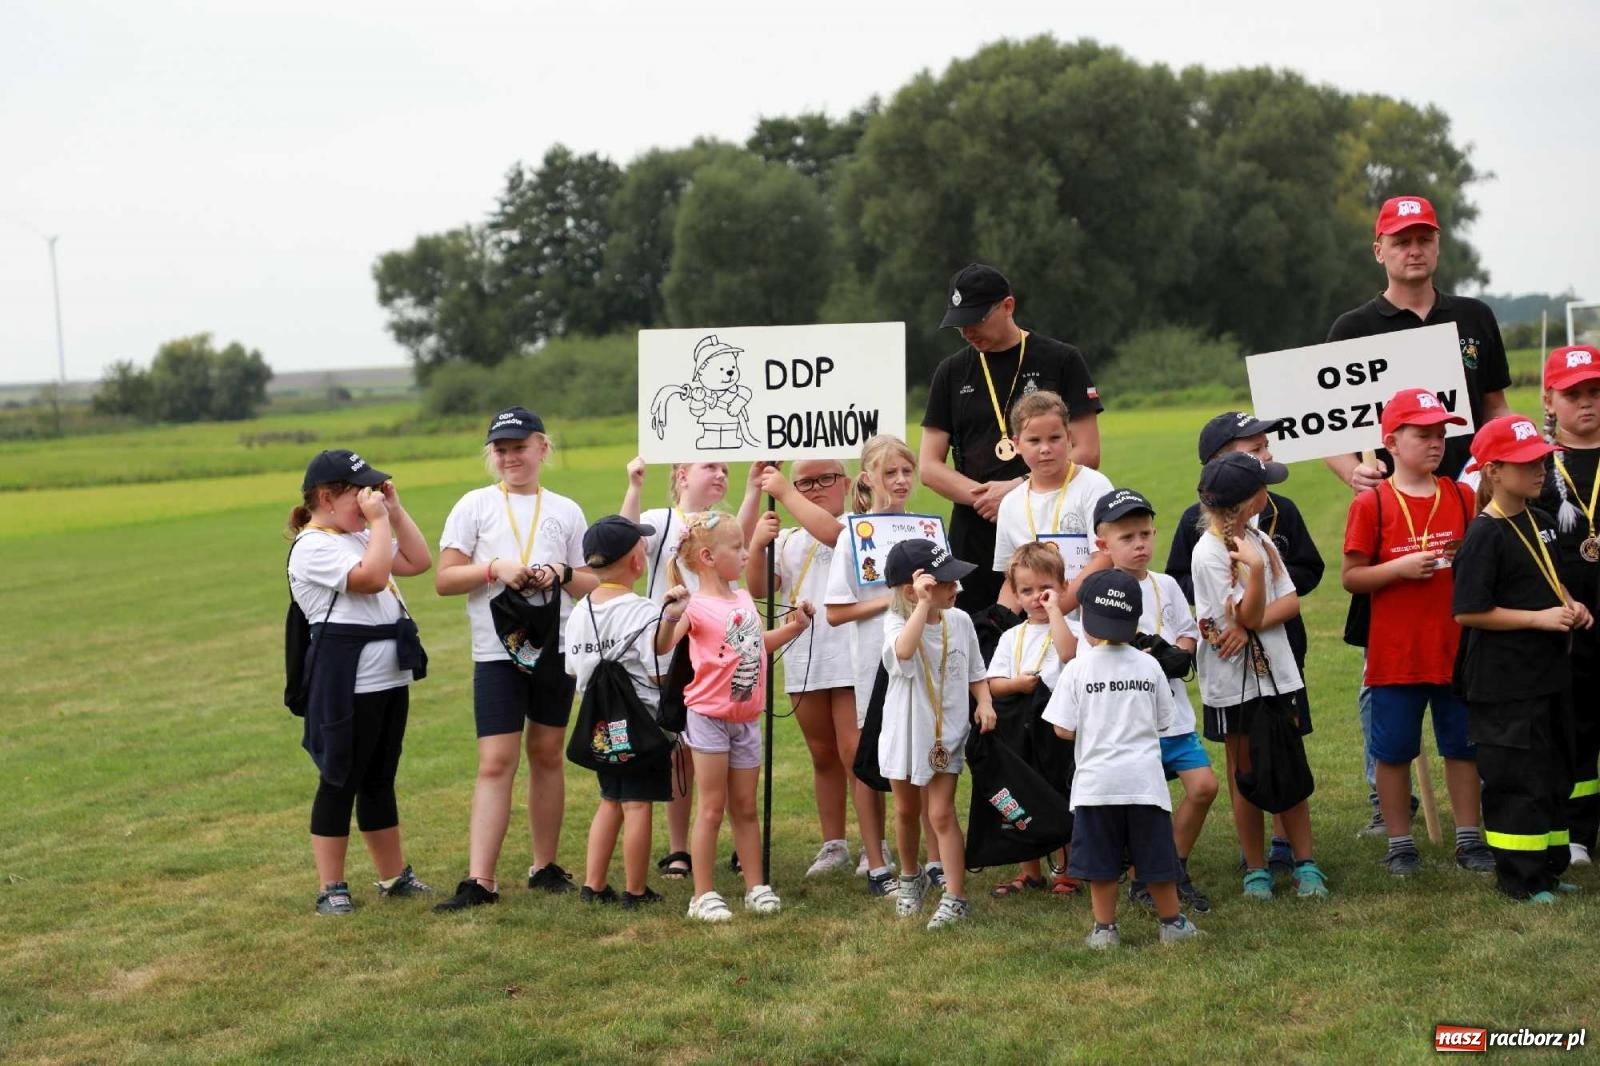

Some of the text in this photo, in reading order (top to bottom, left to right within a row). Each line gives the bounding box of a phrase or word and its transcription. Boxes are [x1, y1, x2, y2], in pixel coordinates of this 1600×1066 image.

[765, 356, 834, 390] DDP
[1317, 358, 1388, 390] OSP
[767, 404, 878, 449] BOJANÓW
[1277, 389, 1457, 441] ROSZW
[1094, 596, 1133, 613] BOJANÓW
[1107, 588, 1126, 599] DDP
[1086, 682, 1106, 694] OSP
